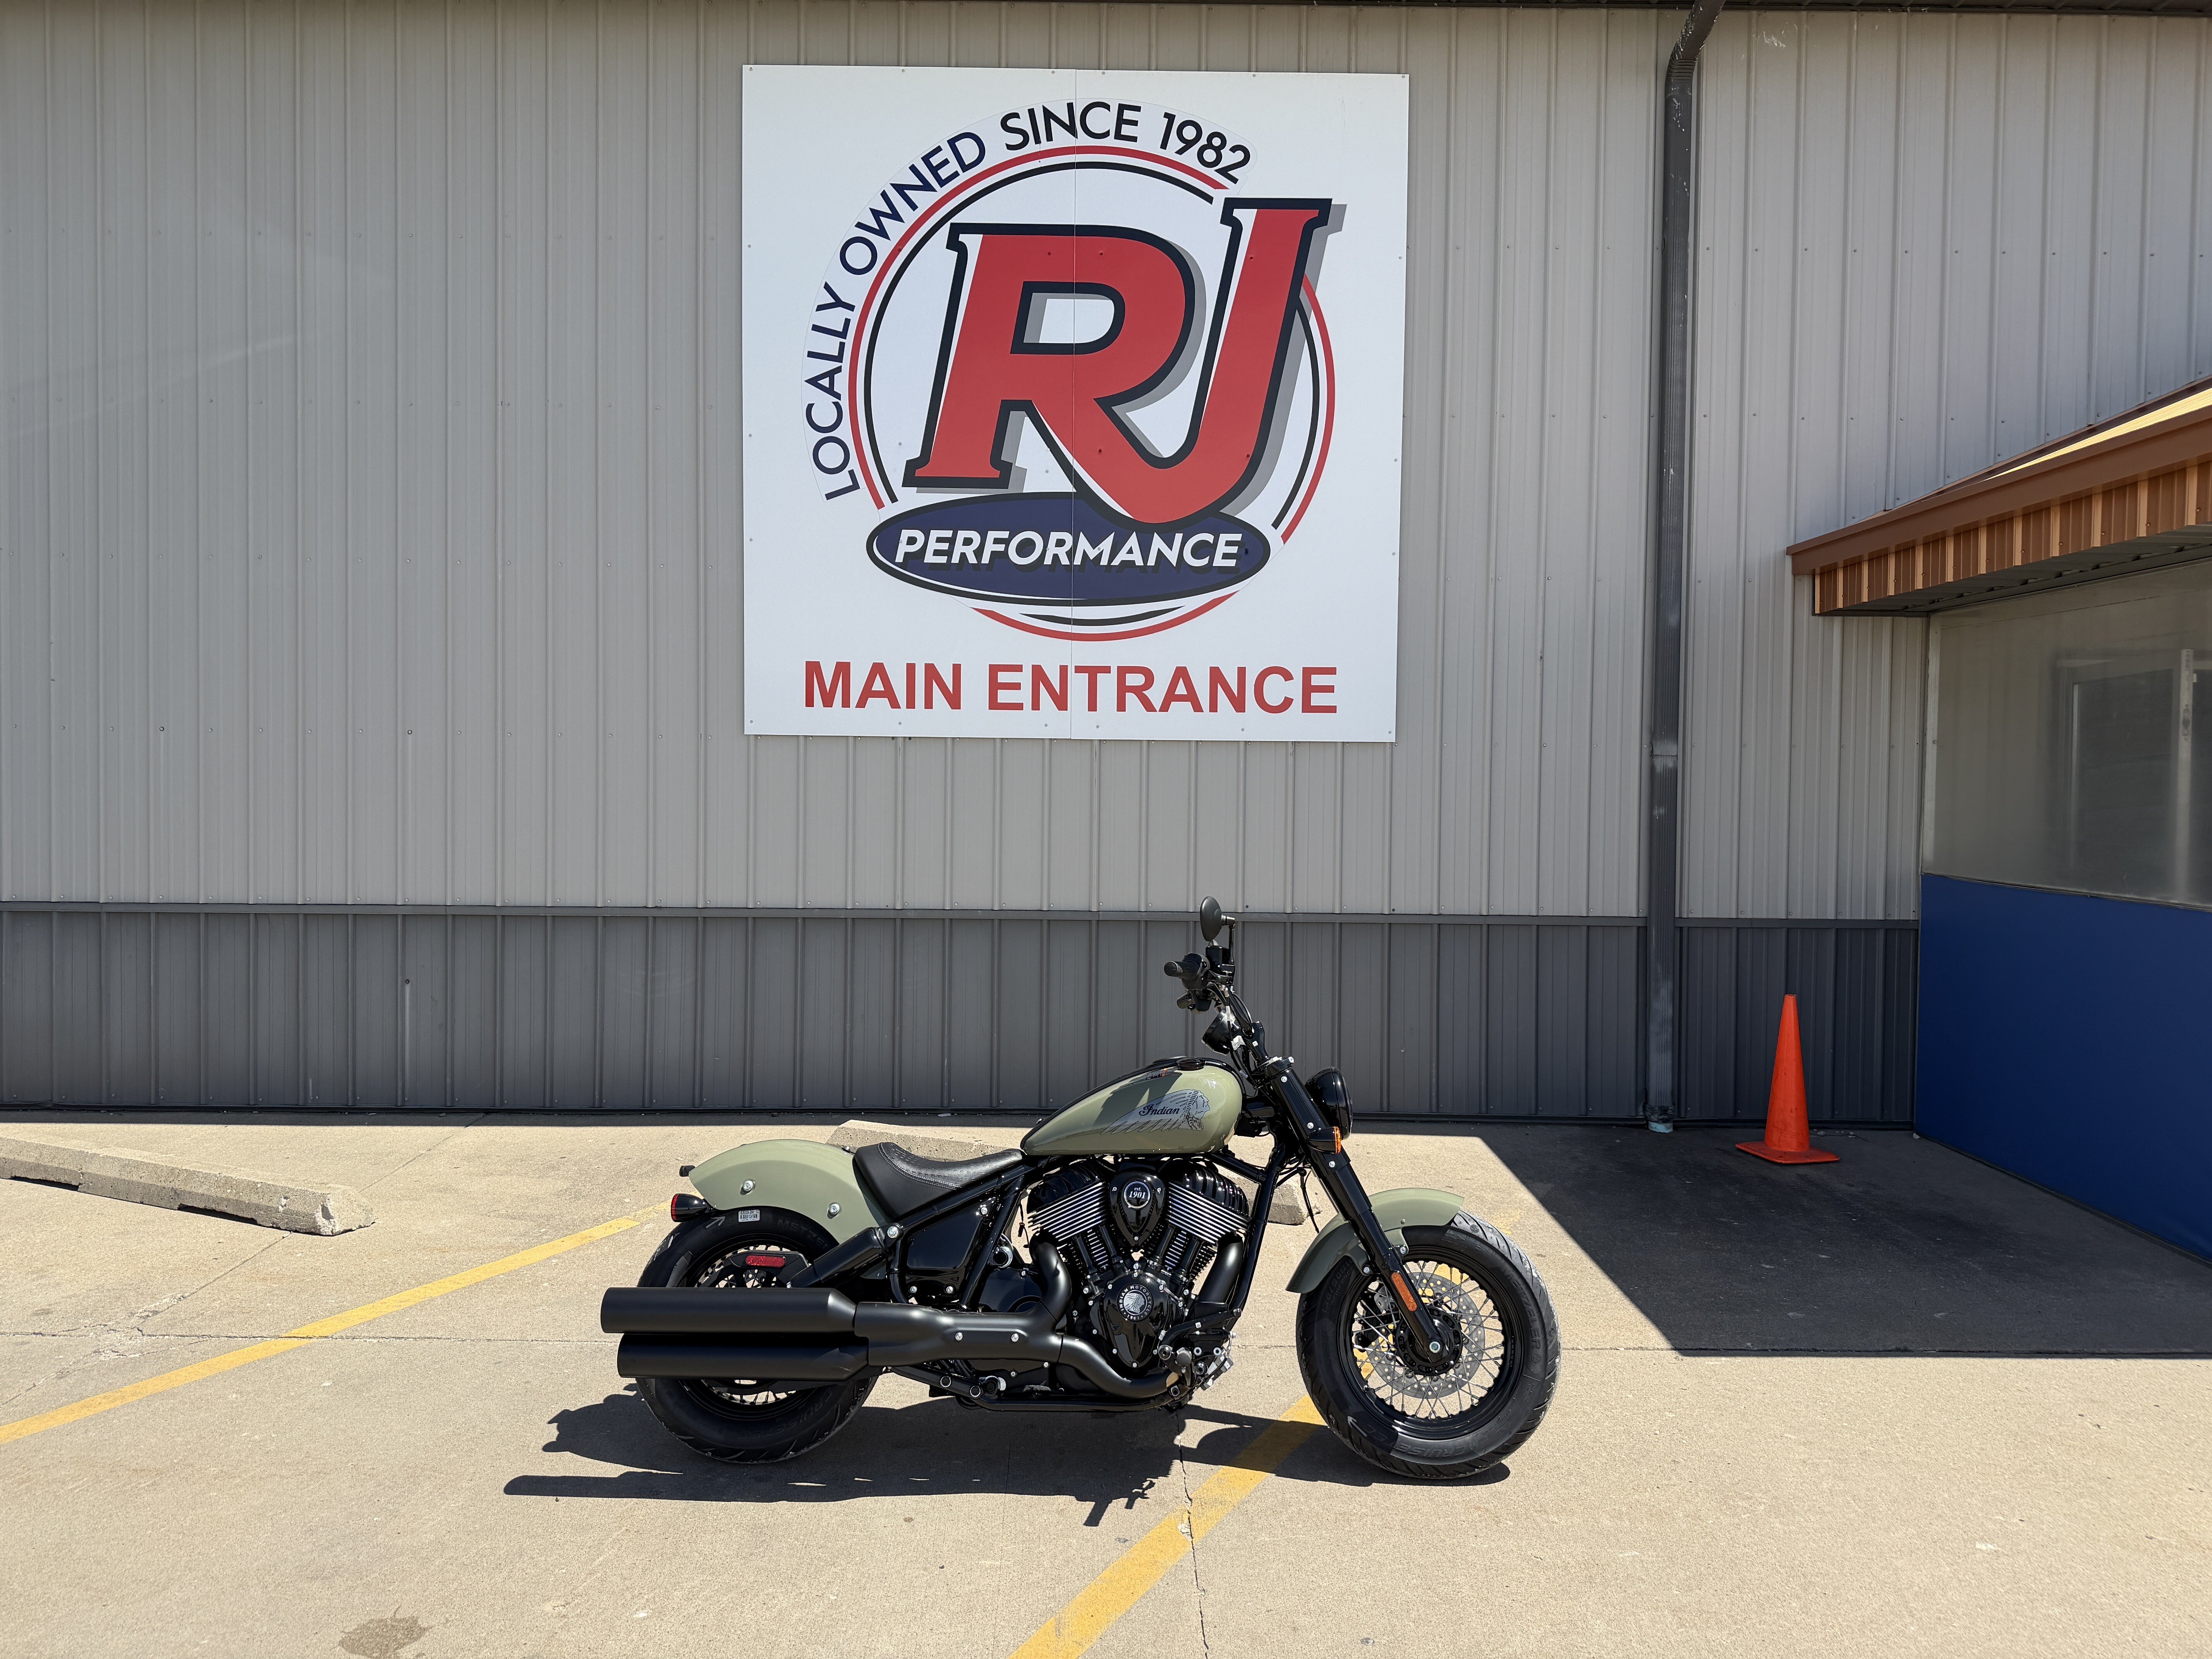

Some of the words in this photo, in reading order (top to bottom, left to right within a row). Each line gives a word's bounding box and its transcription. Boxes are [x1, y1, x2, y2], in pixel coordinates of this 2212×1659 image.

[804, 281, 861, 501] LOCALLY
[839, 132, 986, 275] OWNED
[1000, 101, 1142, 151] SINCE
[1159, 111, 1251, 185] 1982
[901, 198, 1333, 531] RJ
[895, 529, 1243, 567] PERFORMANCE
[805, 661, 962, 710] MAIN
[989, 664, 1337, 714] ENTRANCE
[1139, 1104, 1180, 1116] Indian
[1119, 1288, 1128, 1311] INDIAN
[1130, 1285, 1152, 1316] MOTORCYCLE
[1501, 1268, 1542, 1350] METZELER
